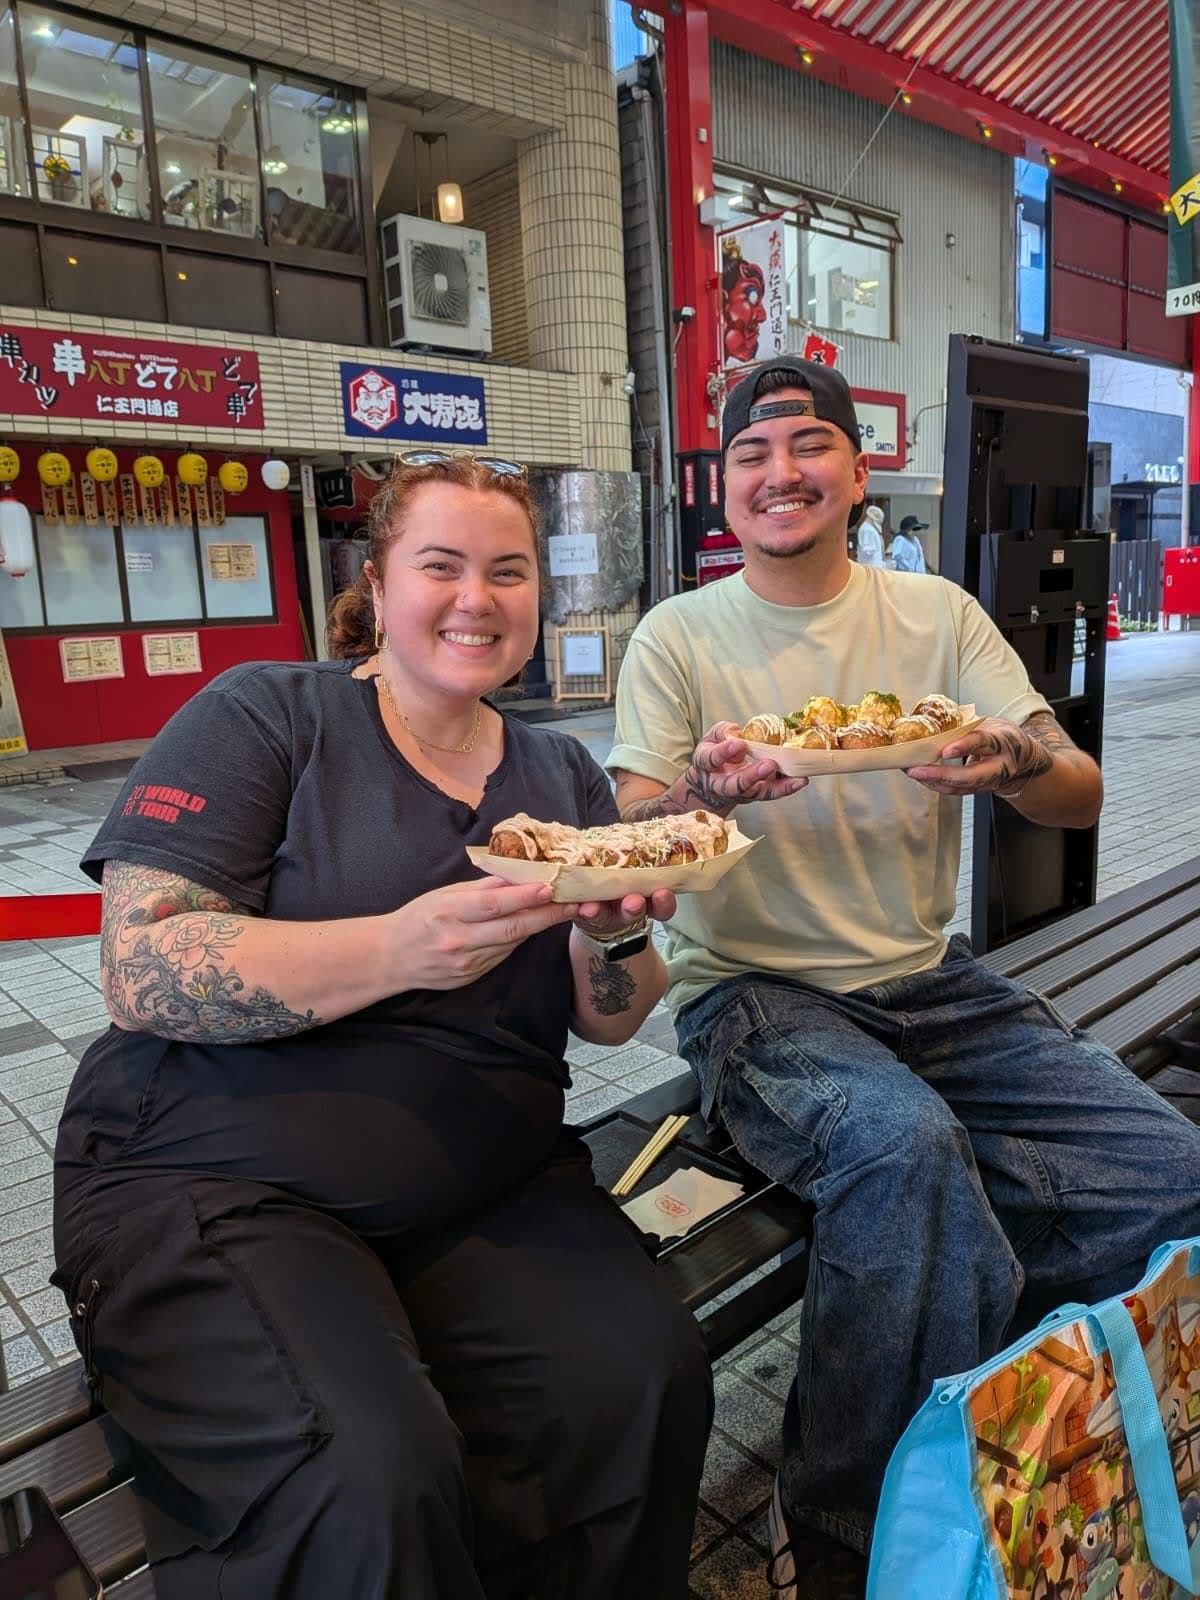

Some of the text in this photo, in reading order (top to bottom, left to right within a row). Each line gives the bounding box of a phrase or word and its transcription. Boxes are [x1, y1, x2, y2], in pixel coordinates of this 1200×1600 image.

[875, 441, 895, 452] SMITH
[82, 478, 97, 520] ハイボール
[137, 800, 180, 824] TOUR
[144, 785, 206, 813] WORLD
